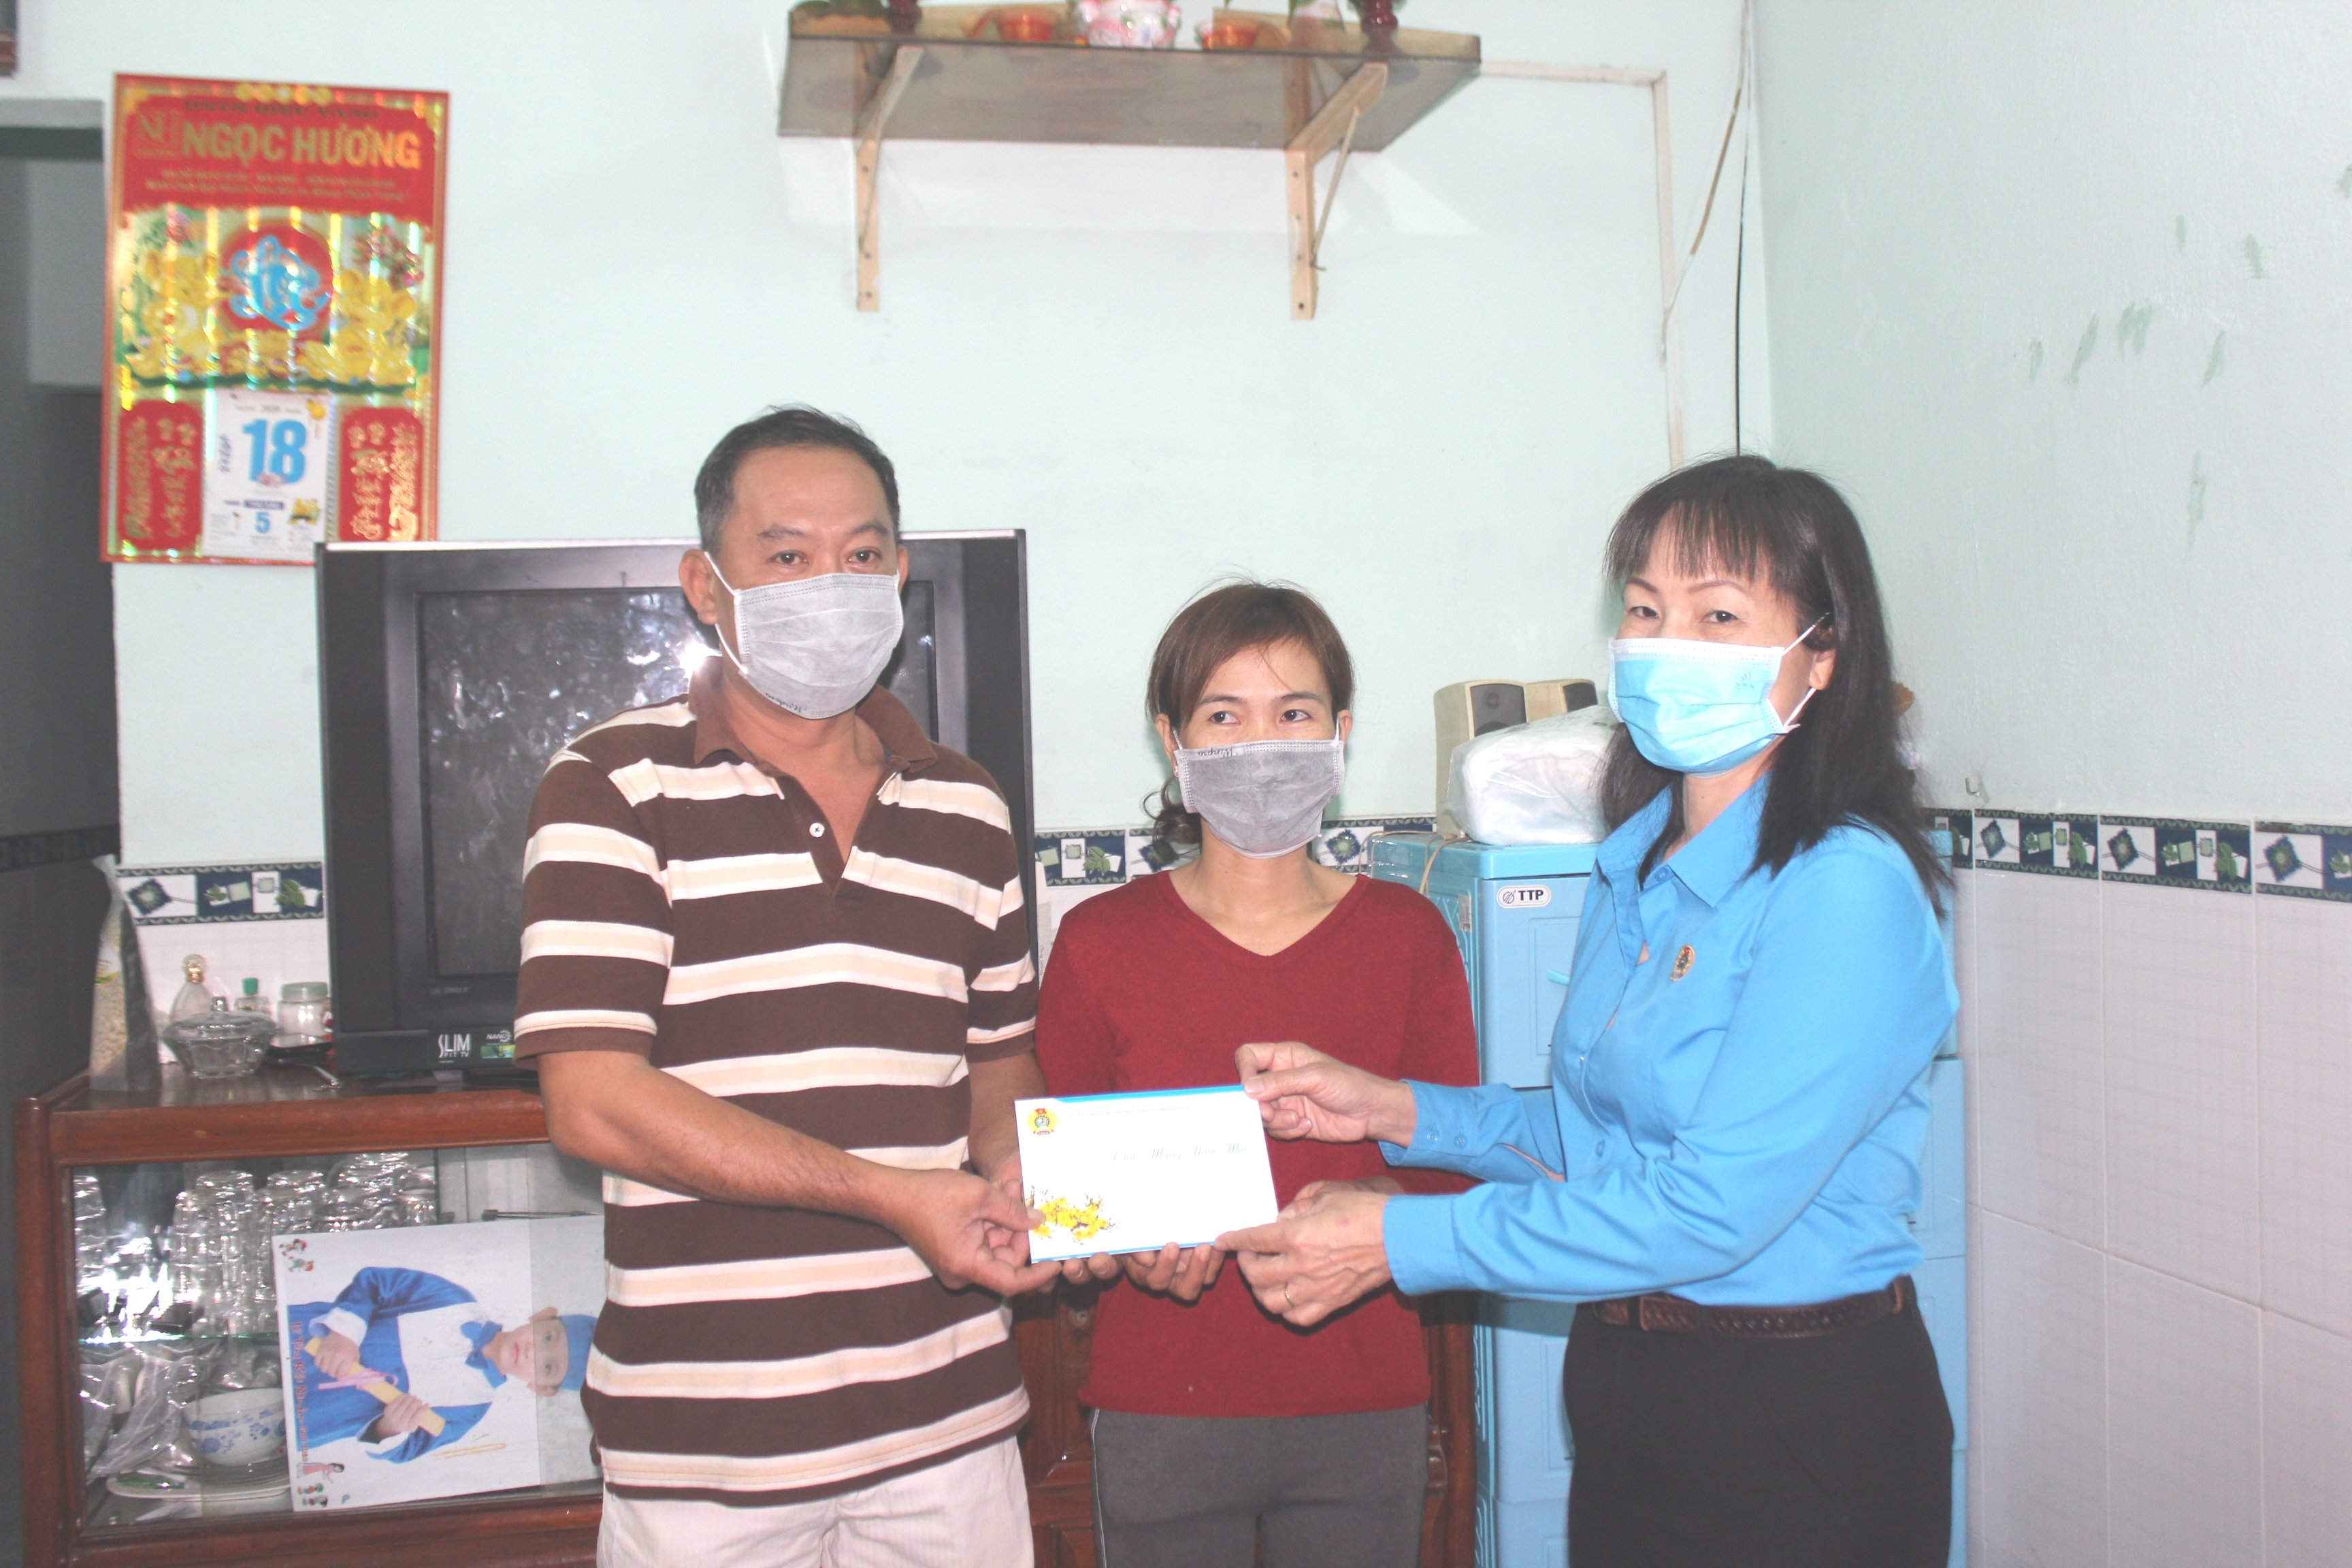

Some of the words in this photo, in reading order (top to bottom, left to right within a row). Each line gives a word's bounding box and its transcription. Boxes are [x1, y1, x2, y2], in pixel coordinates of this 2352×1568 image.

[182, 121, 286, 167] NGỌC
[291, 122, 422, 169] HƯƠNG
[242, 419, 307, 484] 18
[255, 511, 271, 534] 5
[1518, 890, 1544, 901] TTP
[438, 1034, 471, 1058] SLIM
